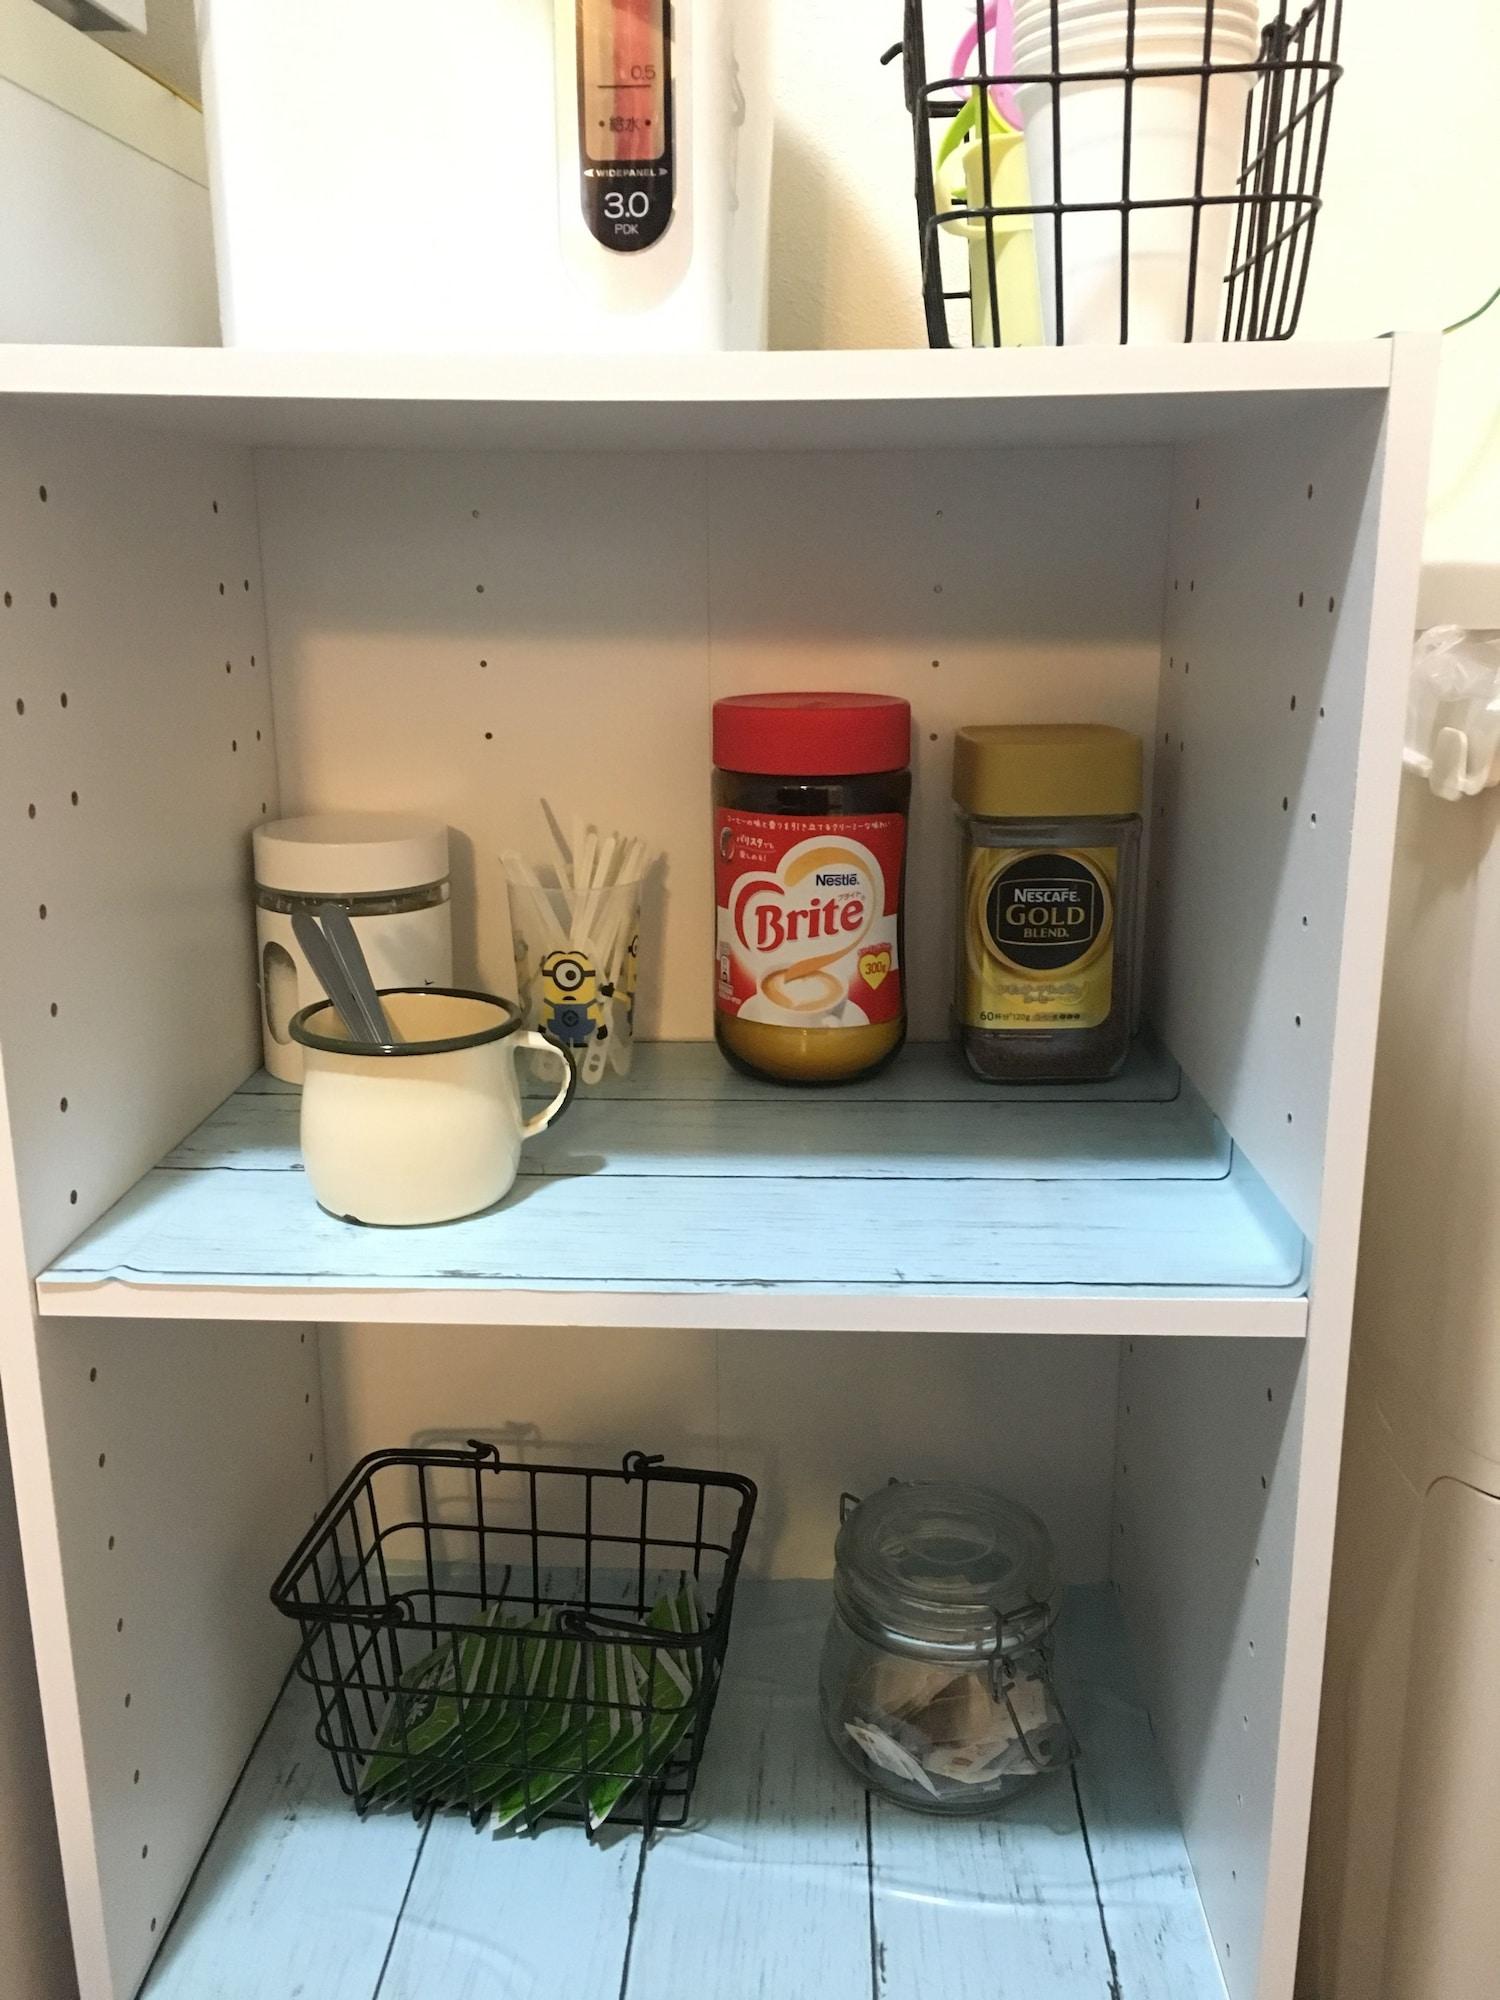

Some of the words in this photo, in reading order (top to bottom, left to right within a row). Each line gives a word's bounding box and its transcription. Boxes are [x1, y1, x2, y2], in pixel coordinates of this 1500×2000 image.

[630, 65, 656, 80] 0.5
[609, 116, 639, 132] 給水
[604, 191, 649, 218] 3.0
[614, 224, 639, 234] PDK
[1006, 904, 1085, 925] GOLD
[755, 898, 864, 951] Brite
